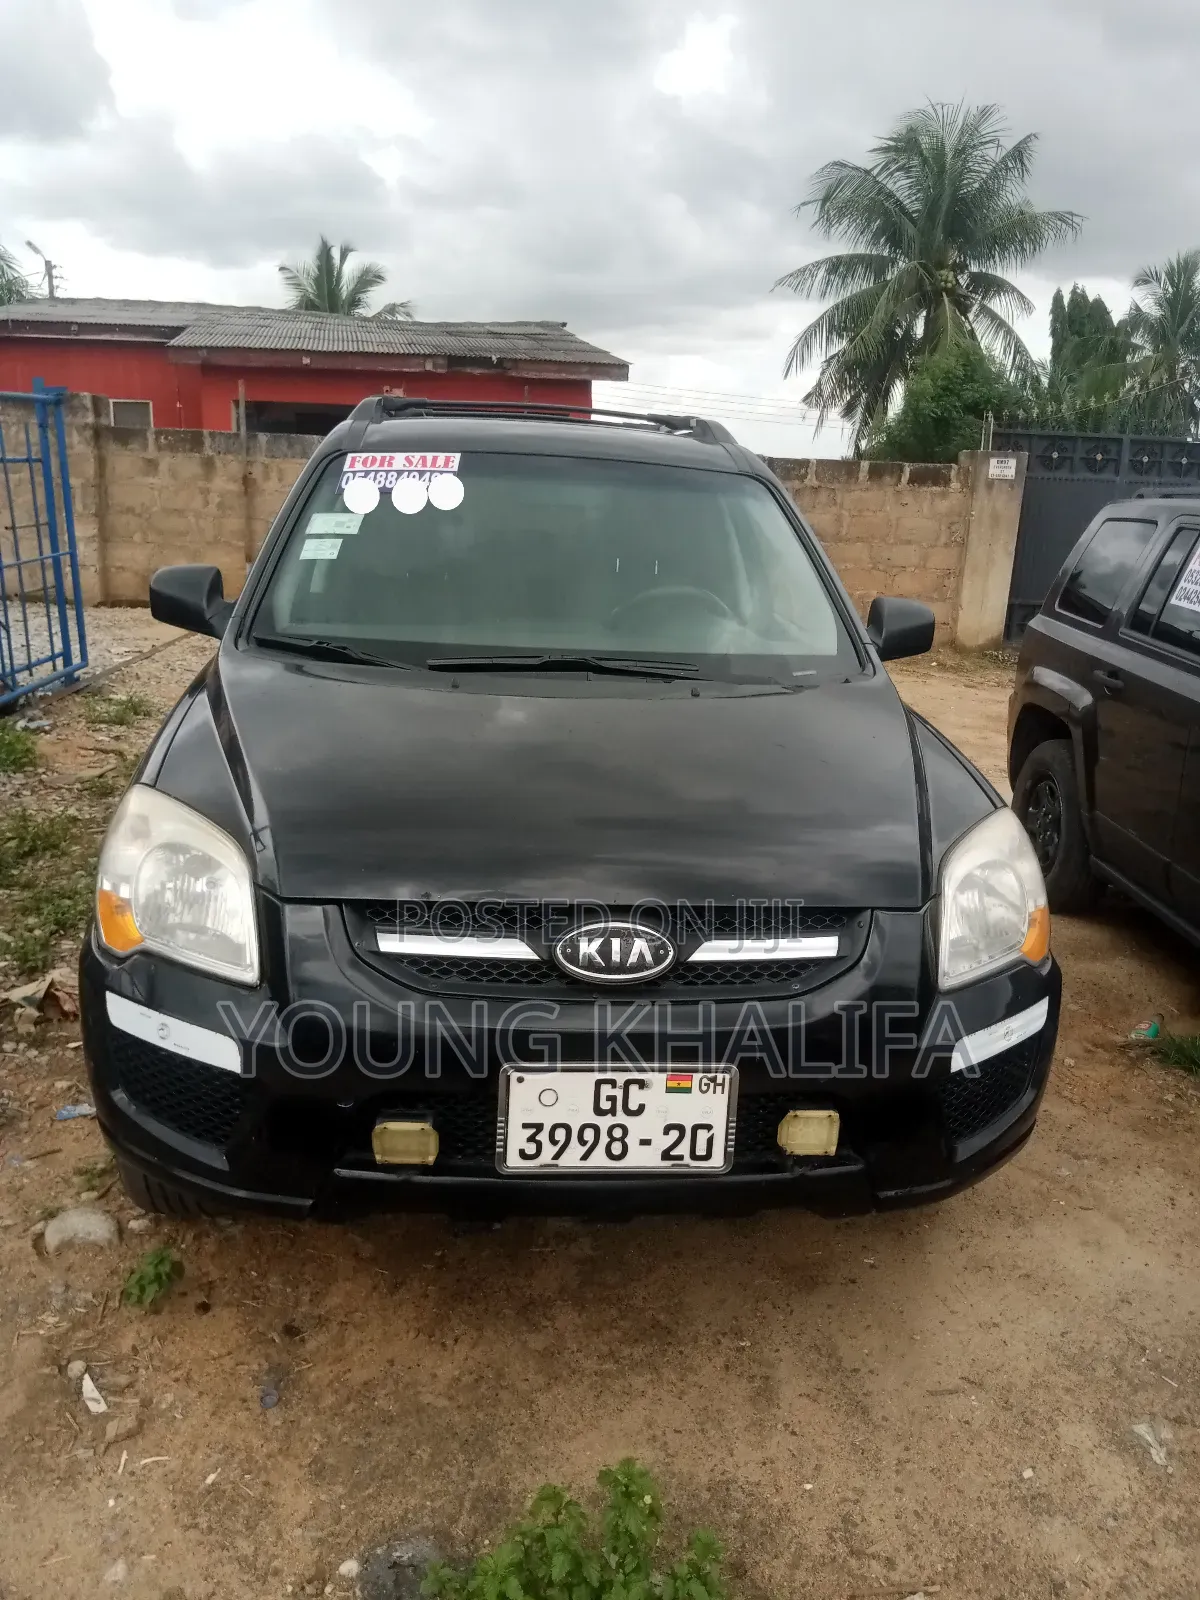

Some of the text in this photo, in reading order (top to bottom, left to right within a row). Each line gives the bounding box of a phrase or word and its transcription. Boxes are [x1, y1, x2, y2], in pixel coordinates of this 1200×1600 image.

[348, 455, 456, 468] FOR SALE
[577, 937, 654, 967] KIA
[592, 1074, 726, 1117] GC GH
[518, 1122, 715, 1162] 3998-20
